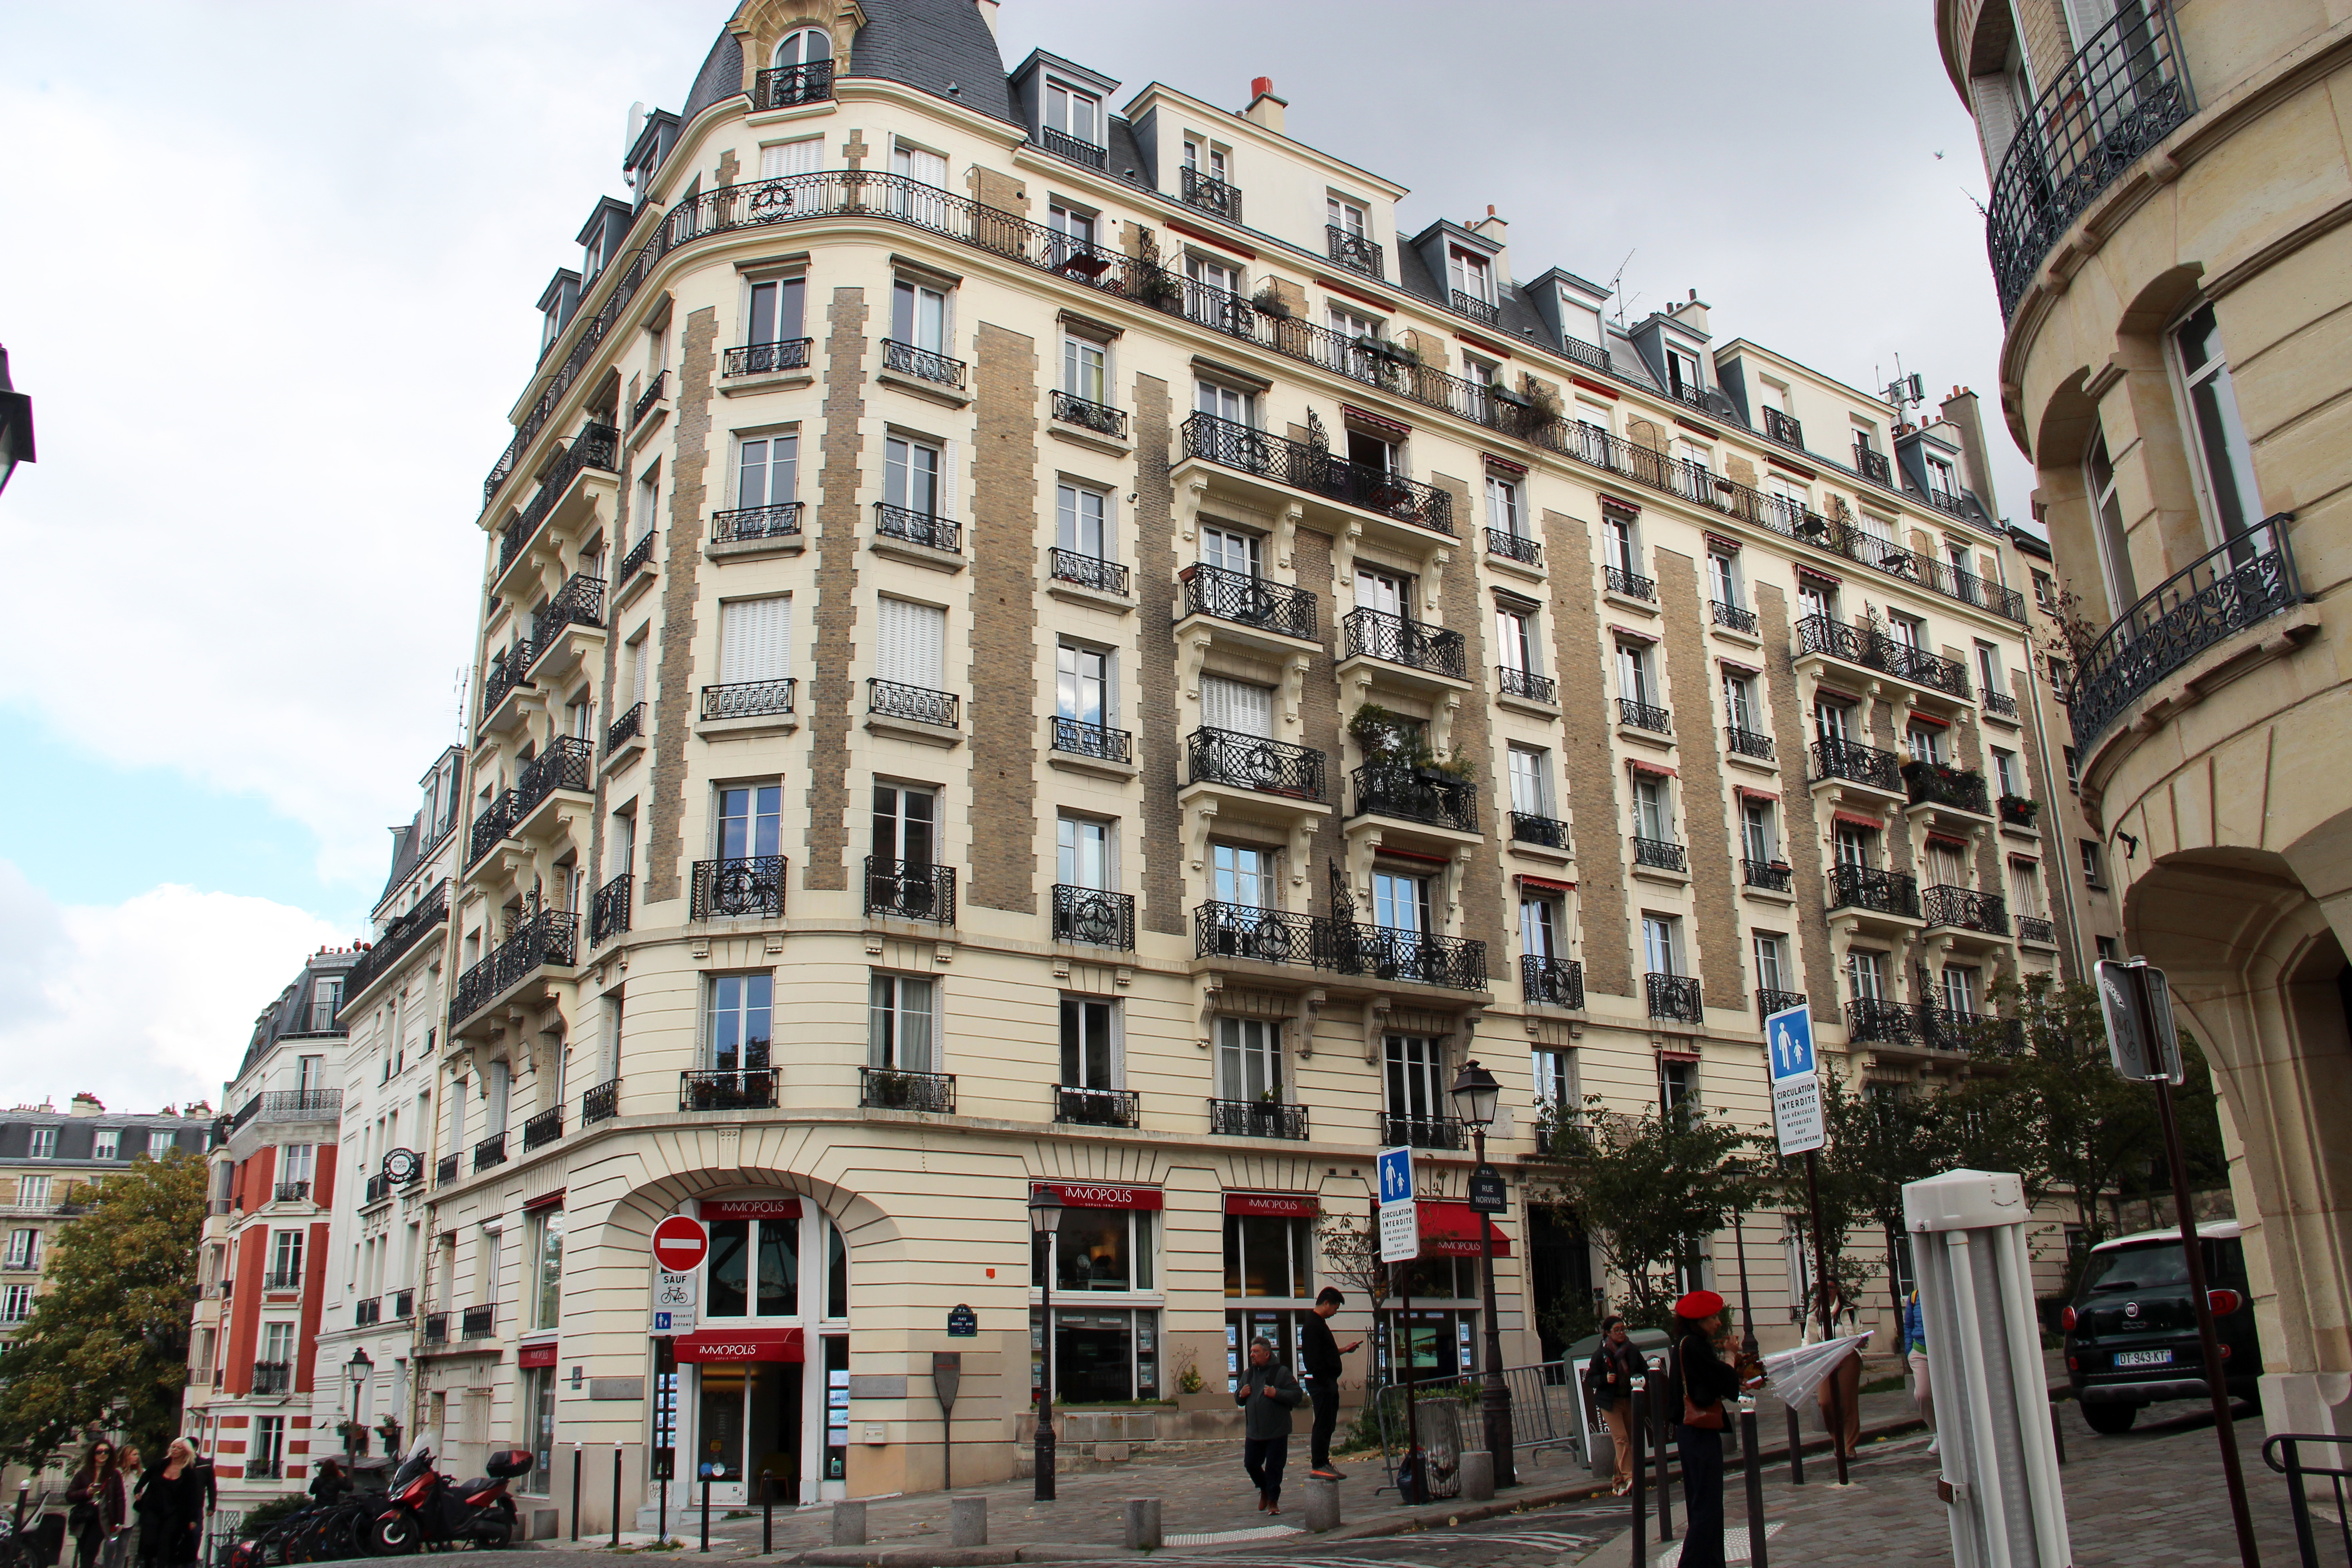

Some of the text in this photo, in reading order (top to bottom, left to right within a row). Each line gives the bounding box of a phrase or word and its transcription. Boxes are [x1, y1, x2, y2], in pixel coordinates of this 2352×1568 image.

[1777, 1083, 1815, 1099] CIRCULATION
[1779, 1095, 1816, 1111] INTERDITE
[1792, 1107, 1815, 1117] VÉHICULES
[1787, 1117, 1812, 1127] MOTORISÉS
[1783, 1134, 1820, 1147] DESSERTE INTERNE
[1475, 1196, 1501, 1204] NORVINS
[1382, 1207, 1412, 1219] CIRCULATION
[1383, 1217, 1412, 1228] INTERDITE
[664, 1275, 686, 1284] SAUF
[2120, 1350, 2165, 1364] DT-943-KT
